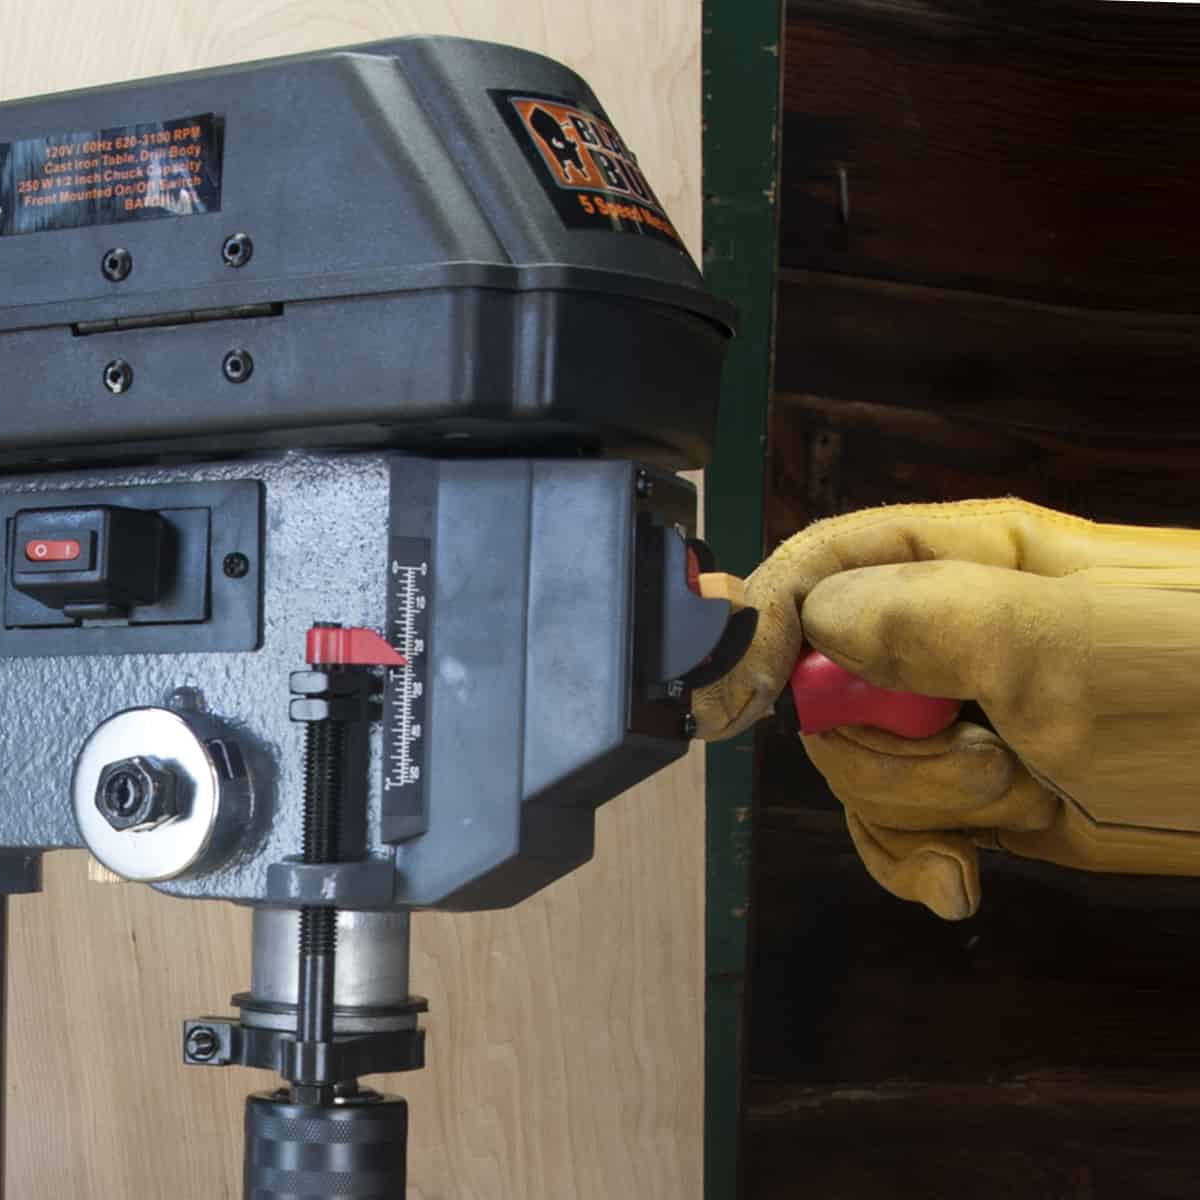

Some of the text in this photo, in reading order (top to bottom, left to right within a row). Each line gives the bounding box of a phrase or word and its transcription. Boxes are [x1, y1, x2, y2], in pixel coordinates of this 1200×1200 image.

[46, 144, 73, 158] 120V
[174, 125, 201, 141] RPM
[44, 160, 73, 175] Cast
[75, 157, 98, 171] Iron
[169, 143, 201, 160] Body
[103, 166, 144, 181] Chuck
[22, 193, 57, 208] Front
[59, 185, 113, 202] Mounted
[578, 193, 594, 215] 5
